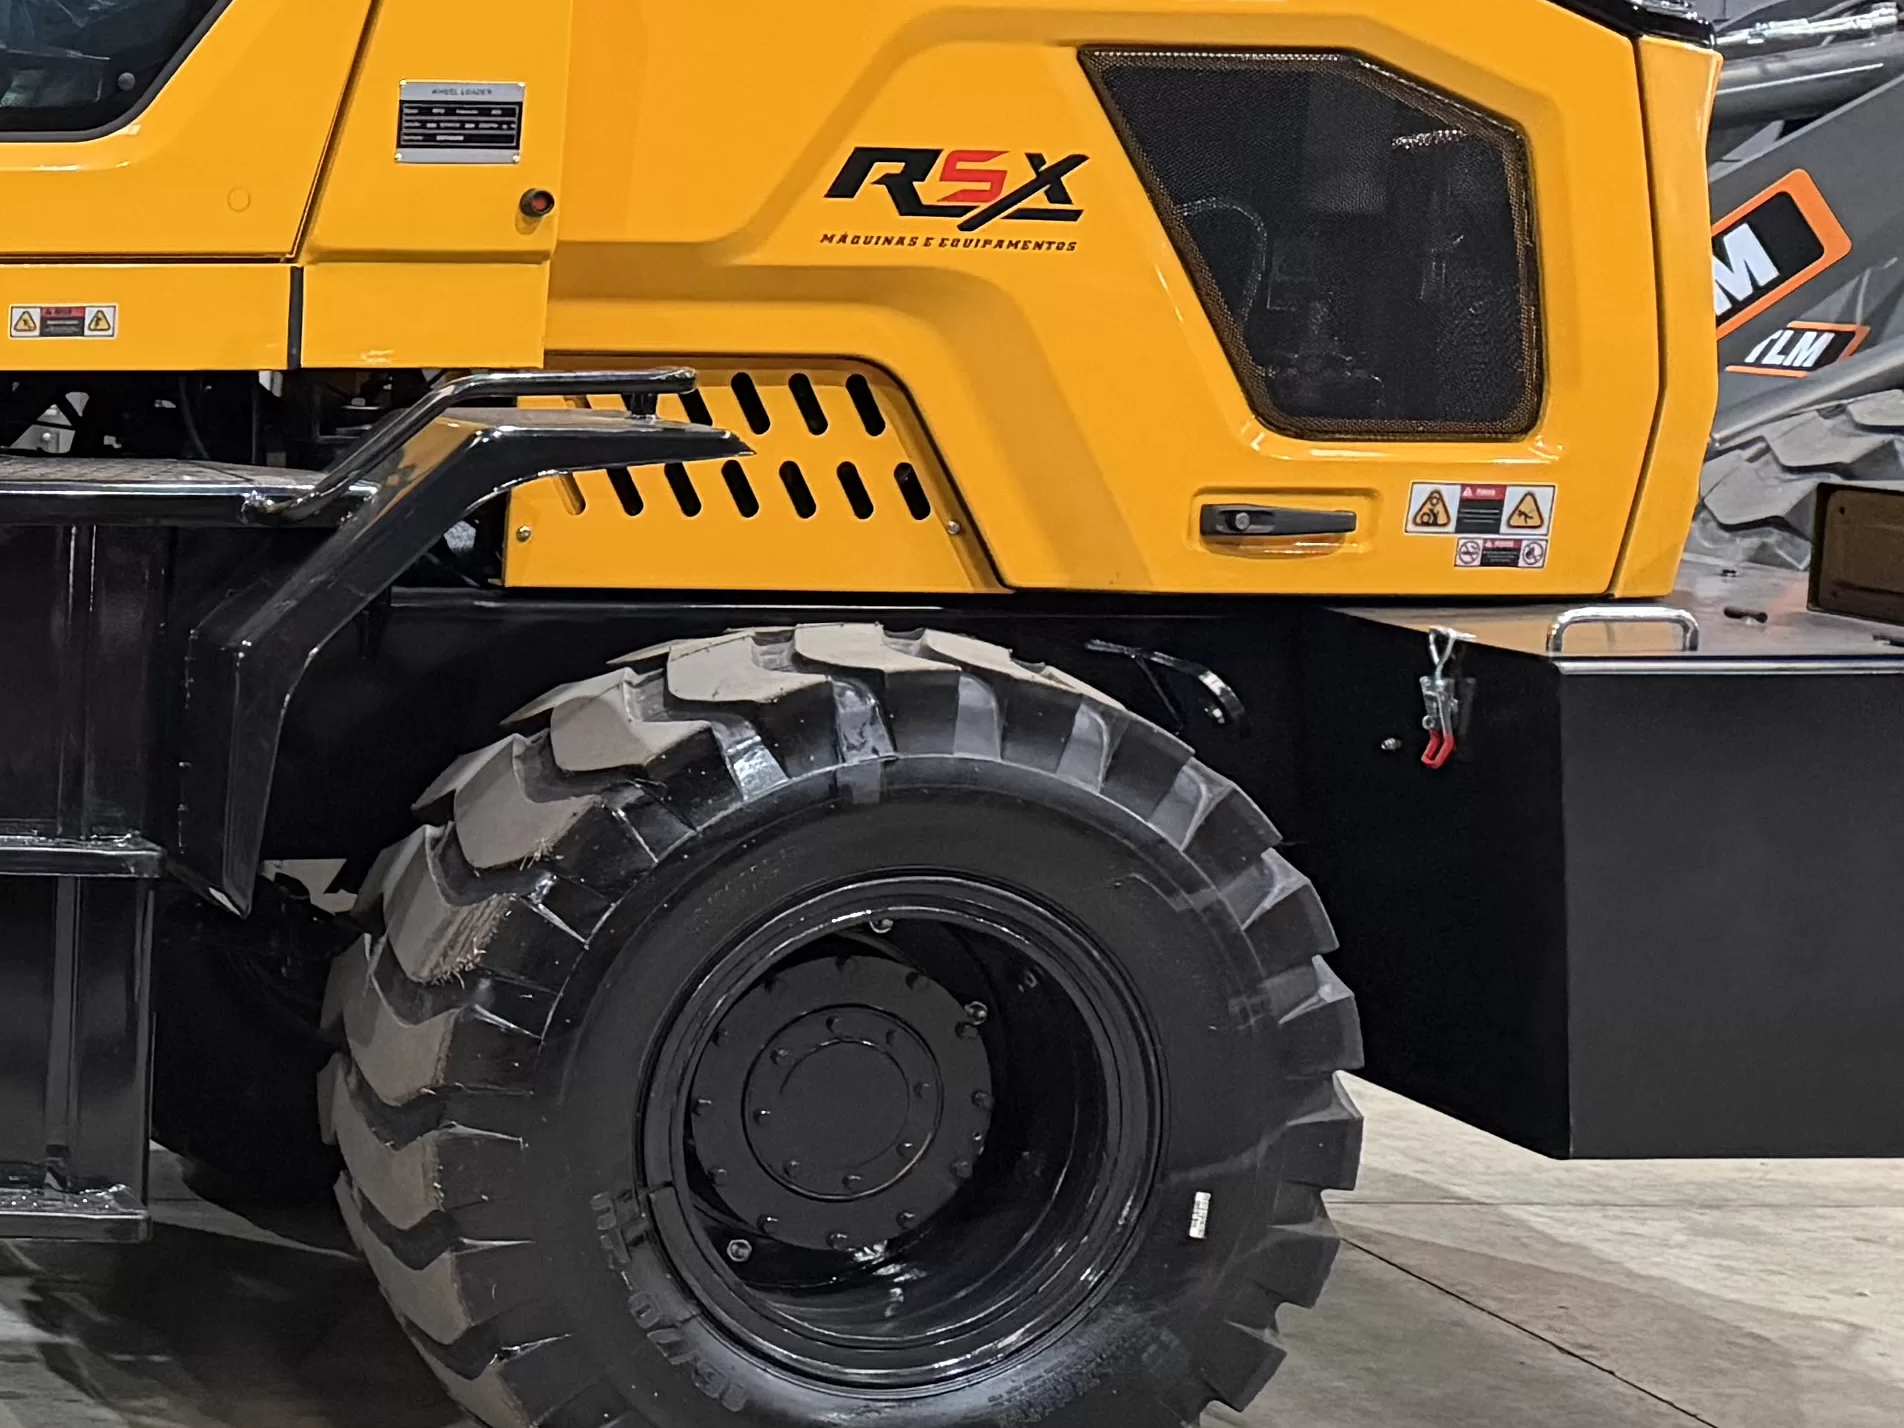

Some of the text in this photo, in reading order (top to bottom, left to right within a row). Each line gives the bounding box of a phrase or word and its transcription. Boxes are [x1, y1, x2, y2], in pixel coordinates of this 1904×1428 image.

[823, 146, 1091, 232] RSX
[923, 236, 935, 248] E
[938, 237, 1078, 252] EQUIPAMENTOS
